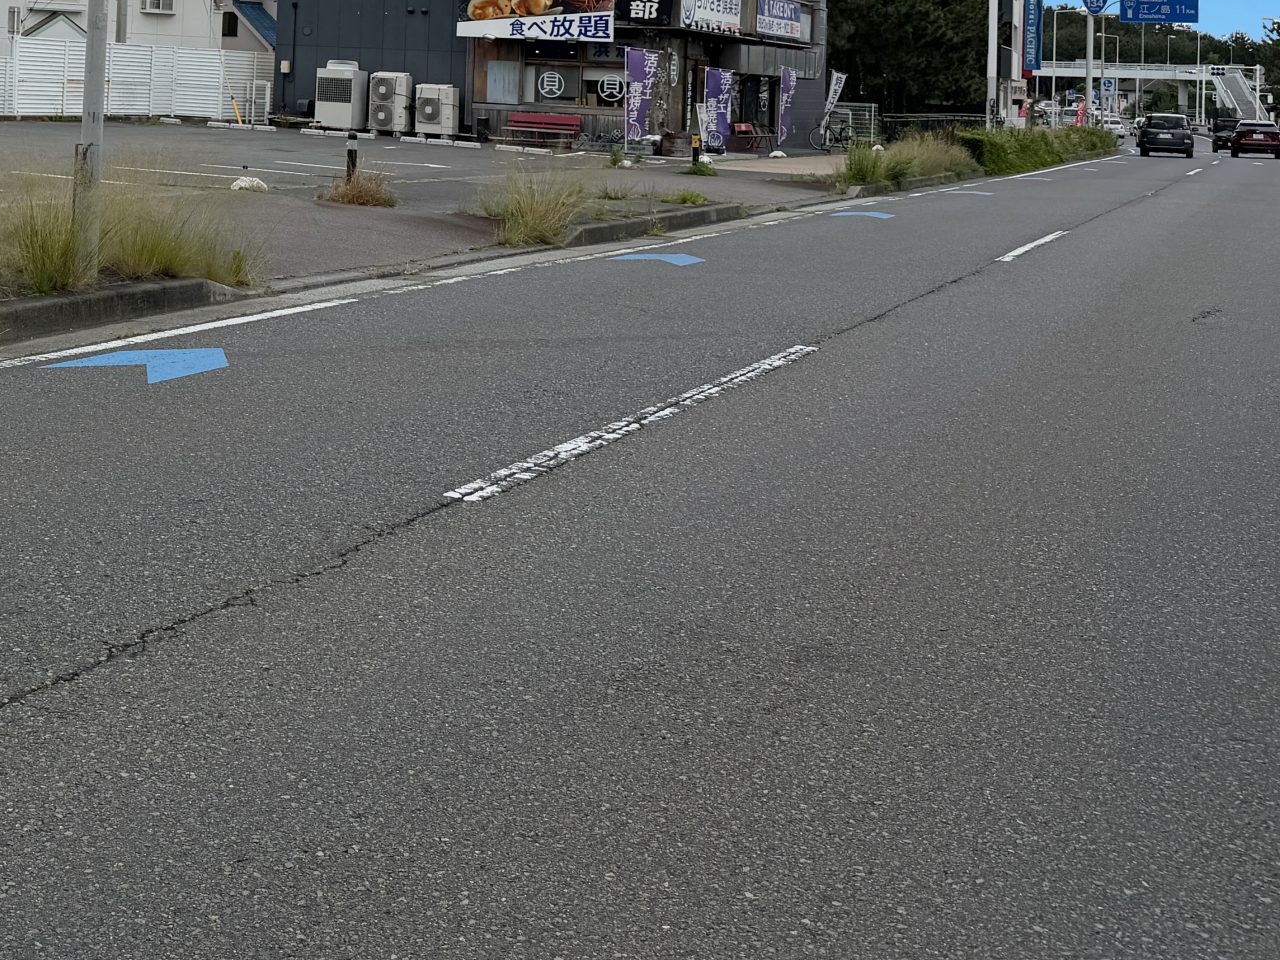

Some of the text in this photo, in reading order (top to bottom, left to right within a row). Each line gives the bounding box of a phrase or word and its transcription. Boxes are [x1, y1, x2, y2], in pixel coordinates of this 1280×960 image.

[1085, 0, 1104, 7] 134
[1139, 5, 1170, 13] 江ノ島
[1176, 5, 1185, 14] 11
[509, 14, 611, 39] 食べ放題
[1026, 26, 1036, 64] PACIFIC
[641, 52, 659, 99] 活サザエ
